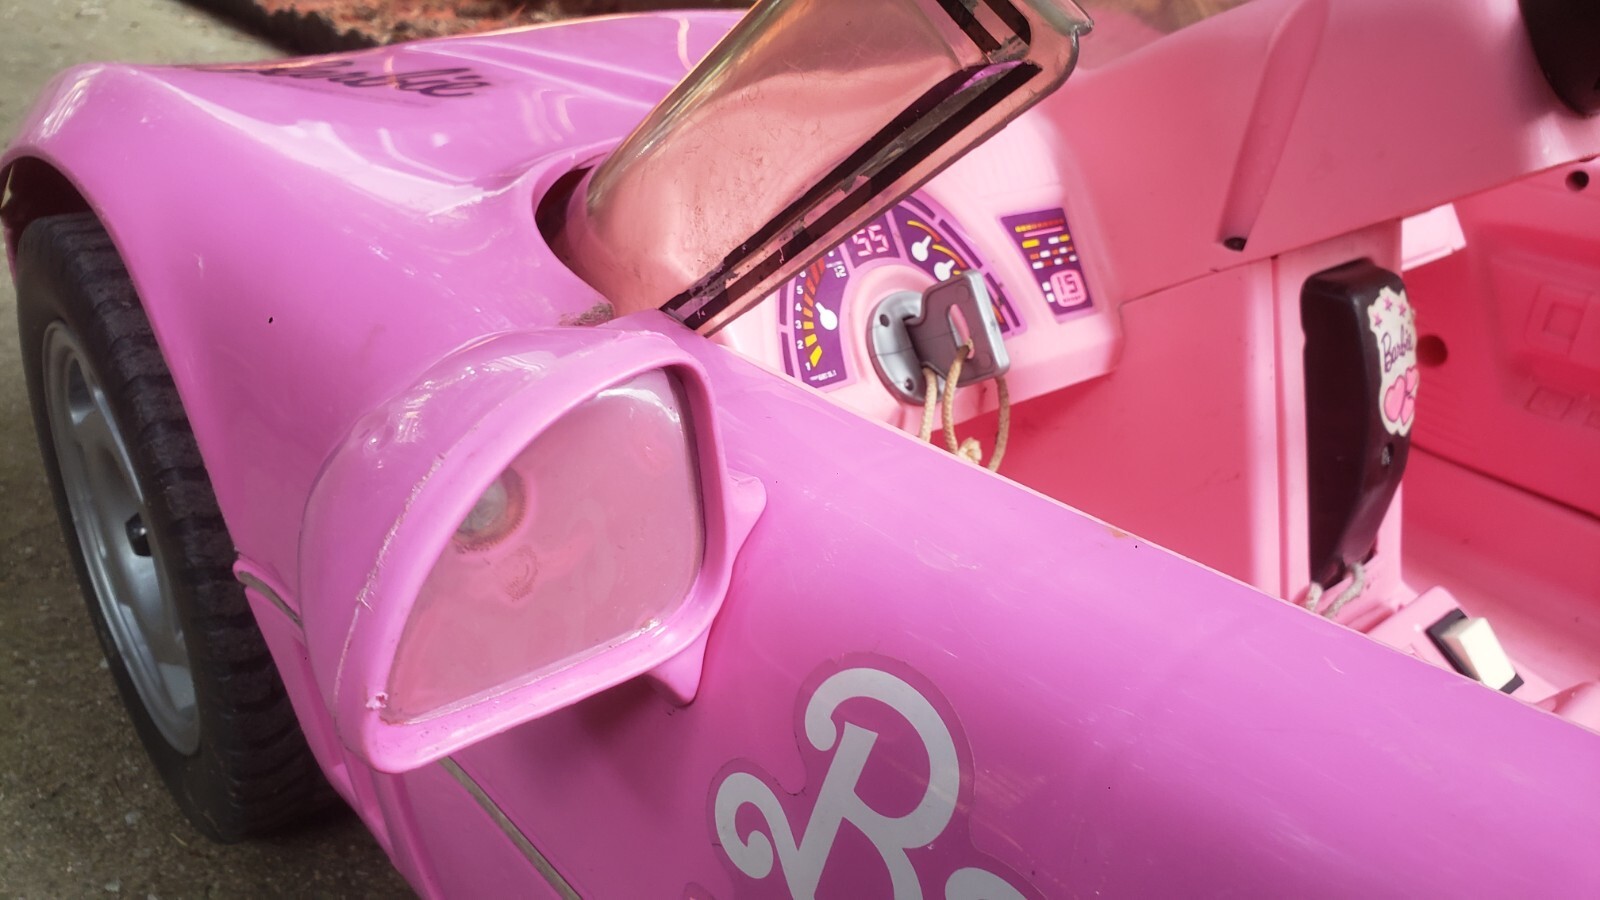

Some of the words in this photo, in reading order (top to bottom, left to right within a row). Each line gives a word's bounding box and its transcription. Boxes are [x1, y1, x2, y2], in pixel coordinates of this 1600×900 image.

[852, 225, 889, 256] 55
[796, 285, 804, 295] 5
[1057, 274, 1078, 296] 15
[794, 302, 803, 312] 4
[794, 320, 803, 330] 3
[796, 340, 805, 350] 2
[804, 361, 811, 371] 1
